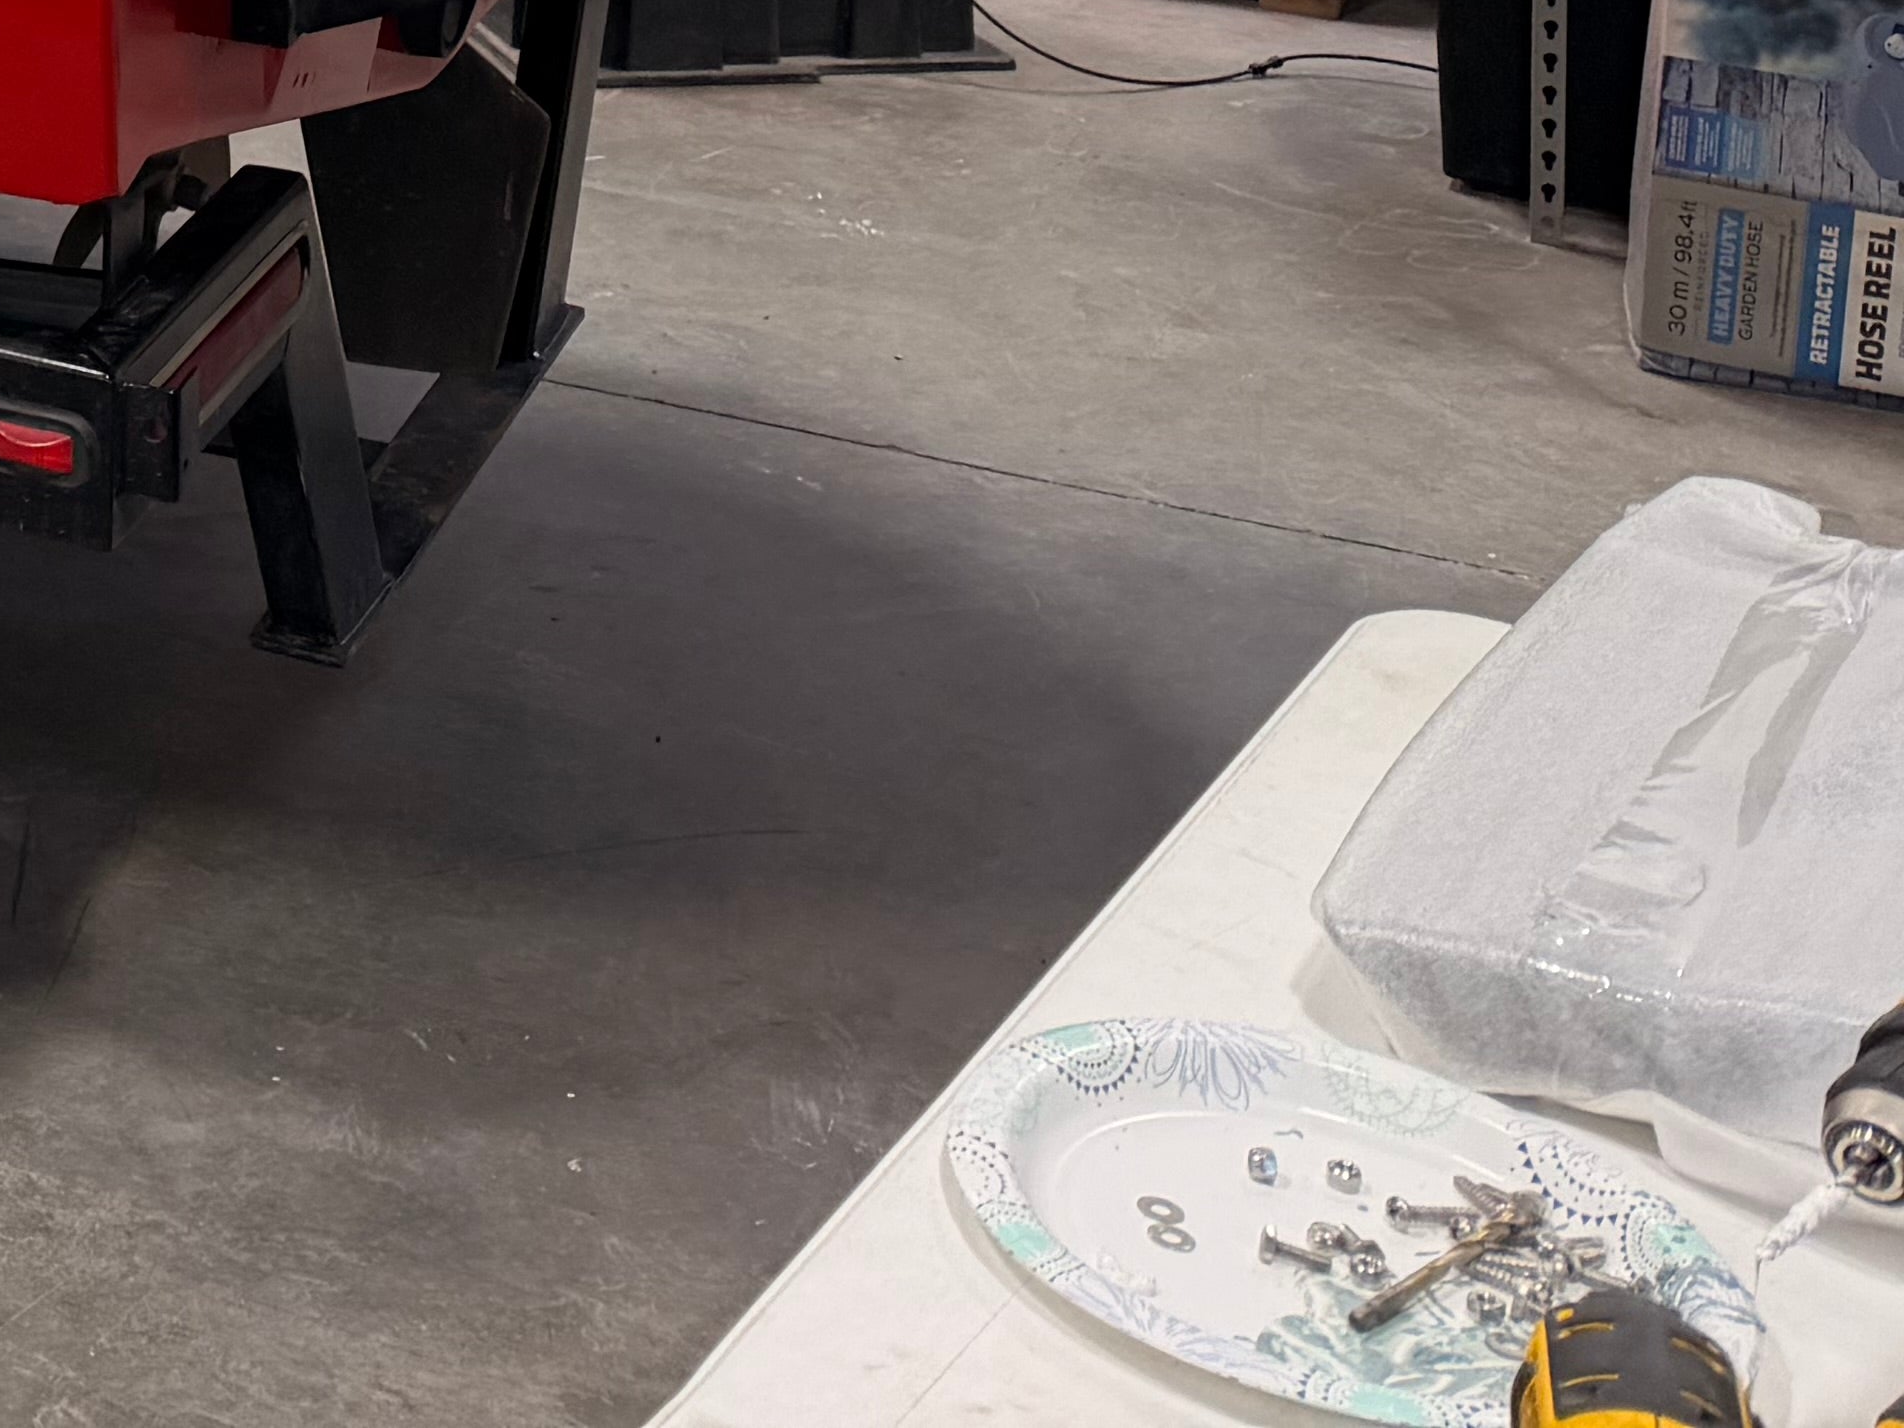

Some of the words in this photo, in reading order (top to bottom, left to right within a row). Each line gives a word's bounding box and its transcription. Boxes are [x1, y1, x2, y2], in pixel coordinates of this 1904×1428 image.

[1720, 214, 1739, 267] DUTY
[1745, 219, 1764, 268] HOSE
[1862, 226, 1897, 301] REEL
[1668, 304, 1687, 336] 30
[1673, 281, 1689, 299] m
[1711, 269, 1734, 337] HEAVY
[1737, 272, 1758, 341] GARDEN
[1809, 224, 1841, 366] RETRACTABLE
[1854, 302, 1889, 382] HOSE
